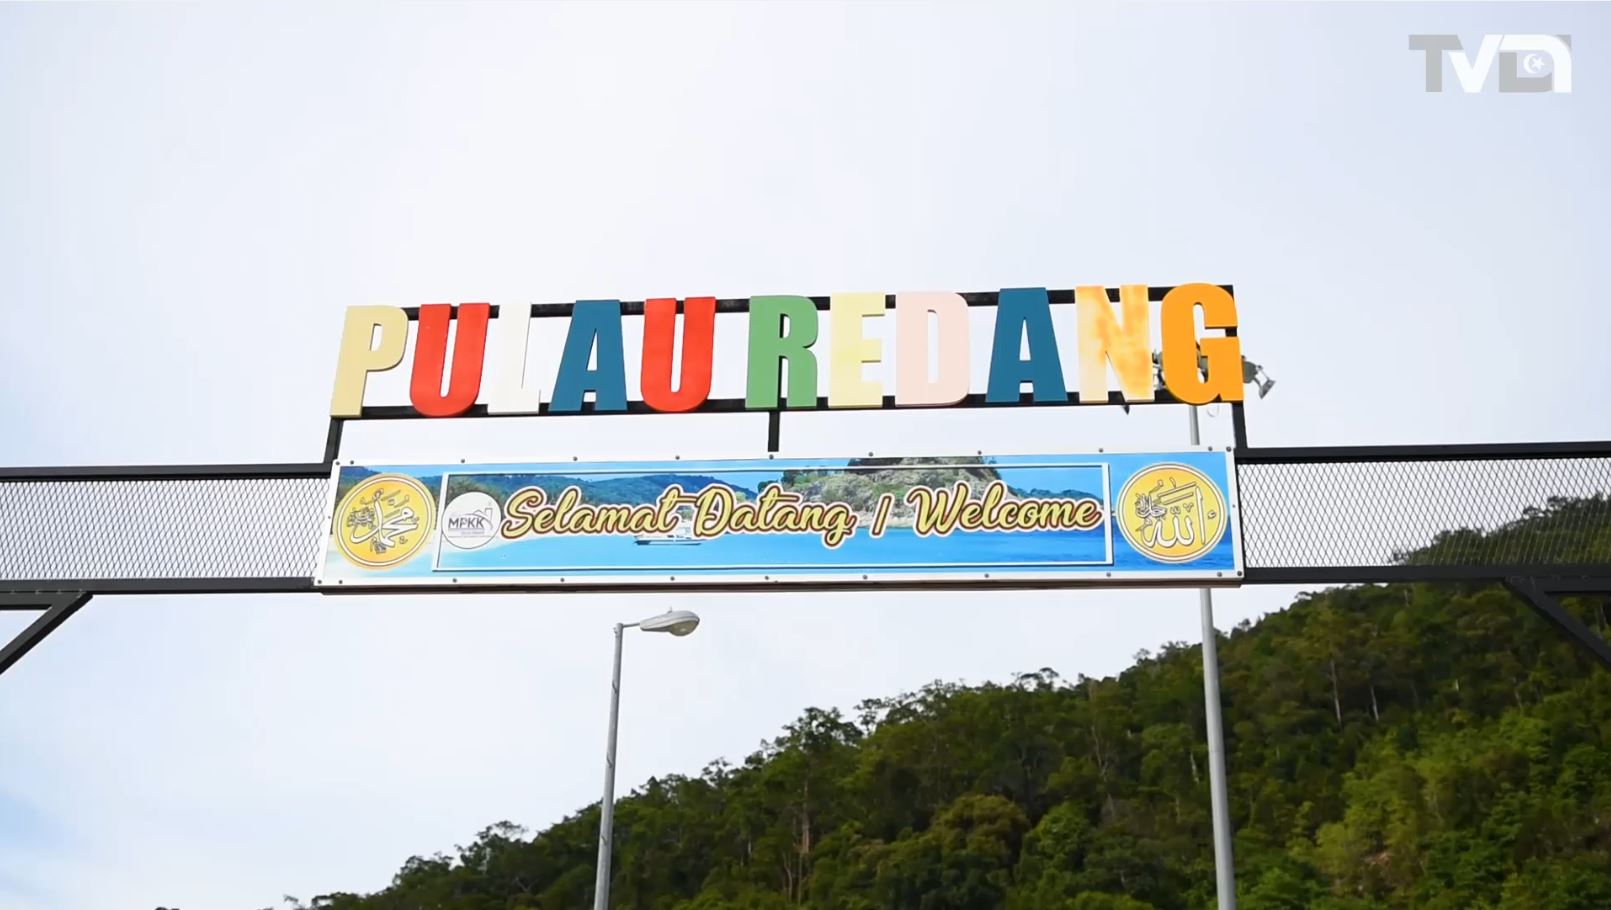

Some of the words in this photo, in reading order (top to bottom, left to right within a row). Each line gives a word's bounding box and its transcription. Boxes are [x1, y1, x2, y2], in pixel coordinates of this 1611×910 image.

[330, 296, 717, 417] PULAU
[745, 282, 1244, 409] REDANG
[448, 517, 484, 529] MPKK
[501, 486, 696, 539] Selamat
[693, 485, 858, 547] Datang
[907, 482, 1102, 535] Welcome
